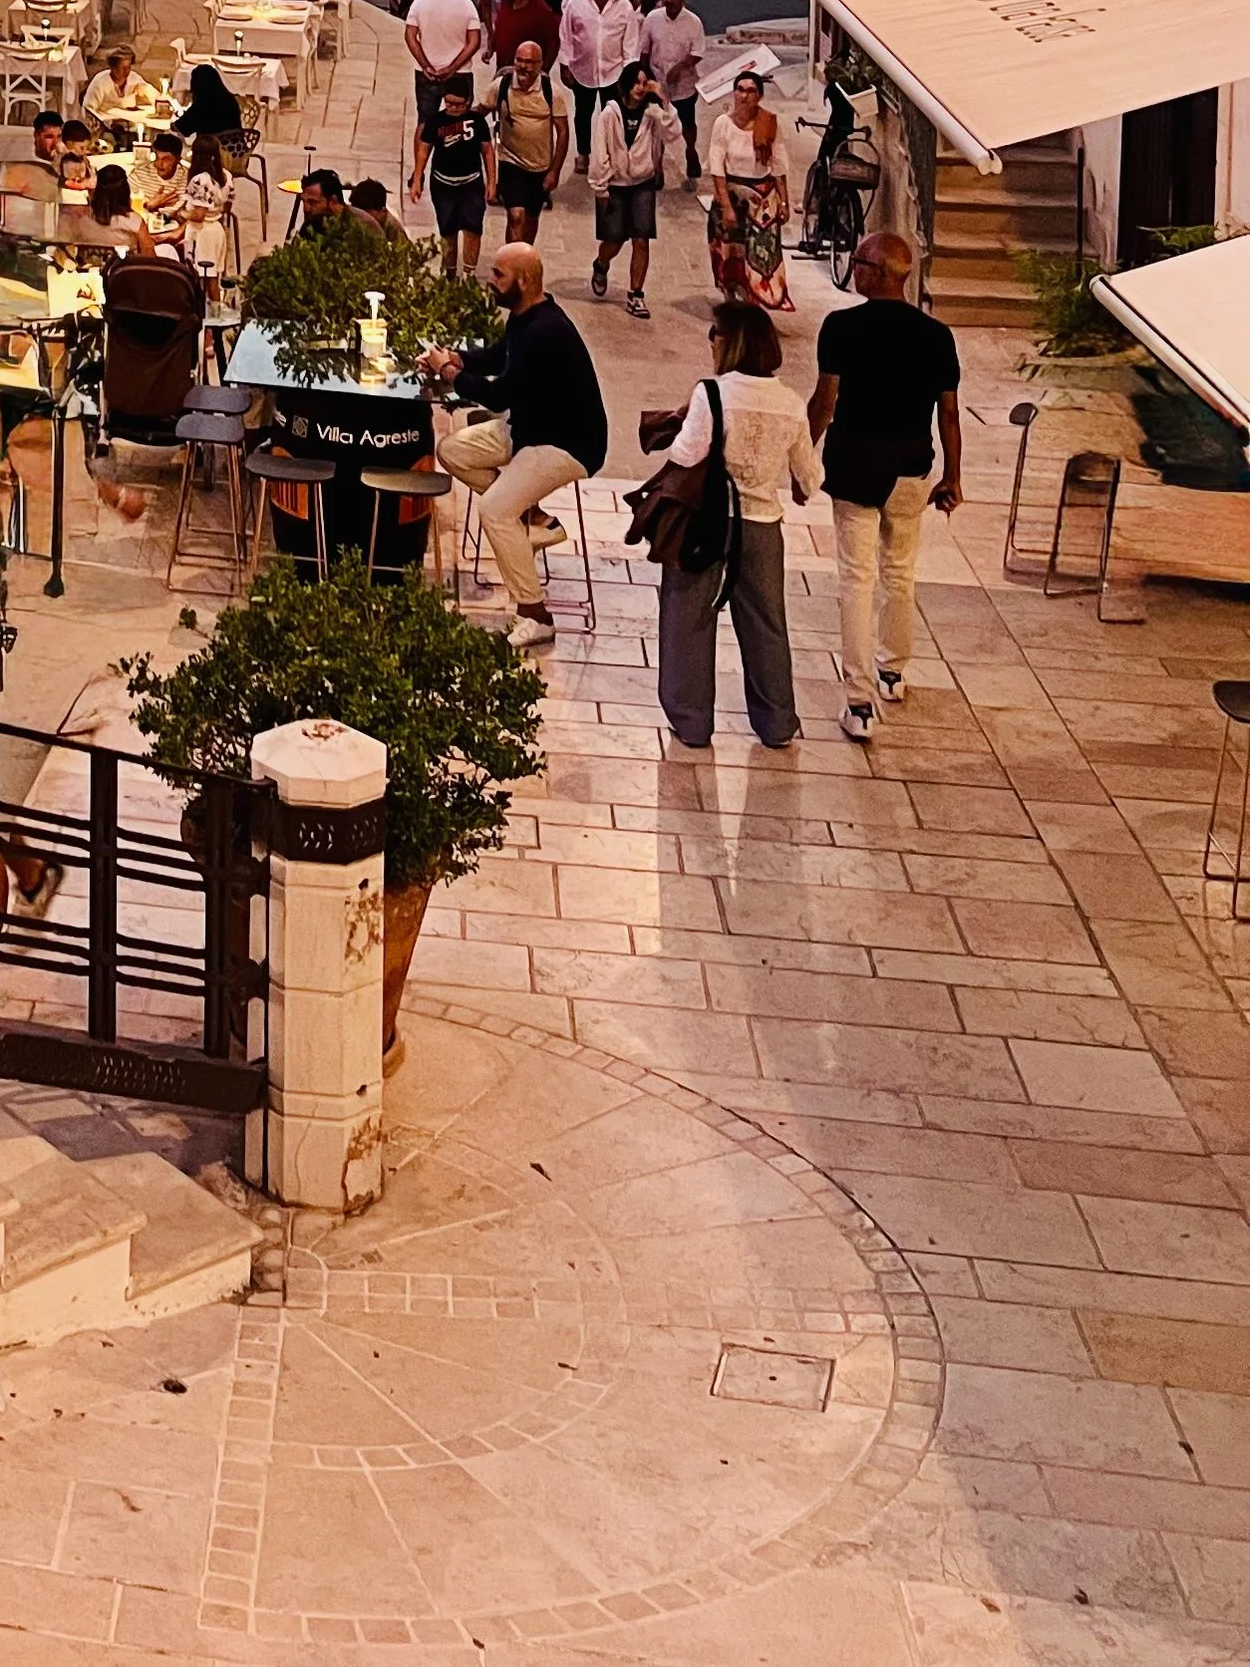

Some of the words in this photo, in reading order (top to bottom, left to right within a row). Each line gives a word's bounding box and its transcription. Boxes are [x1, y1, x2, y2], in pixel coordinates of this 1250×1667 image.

[463, 119, 475, 141] 5
[316, 422, 353, 445] Villa
[359, 428, 421, 449] Agreste
